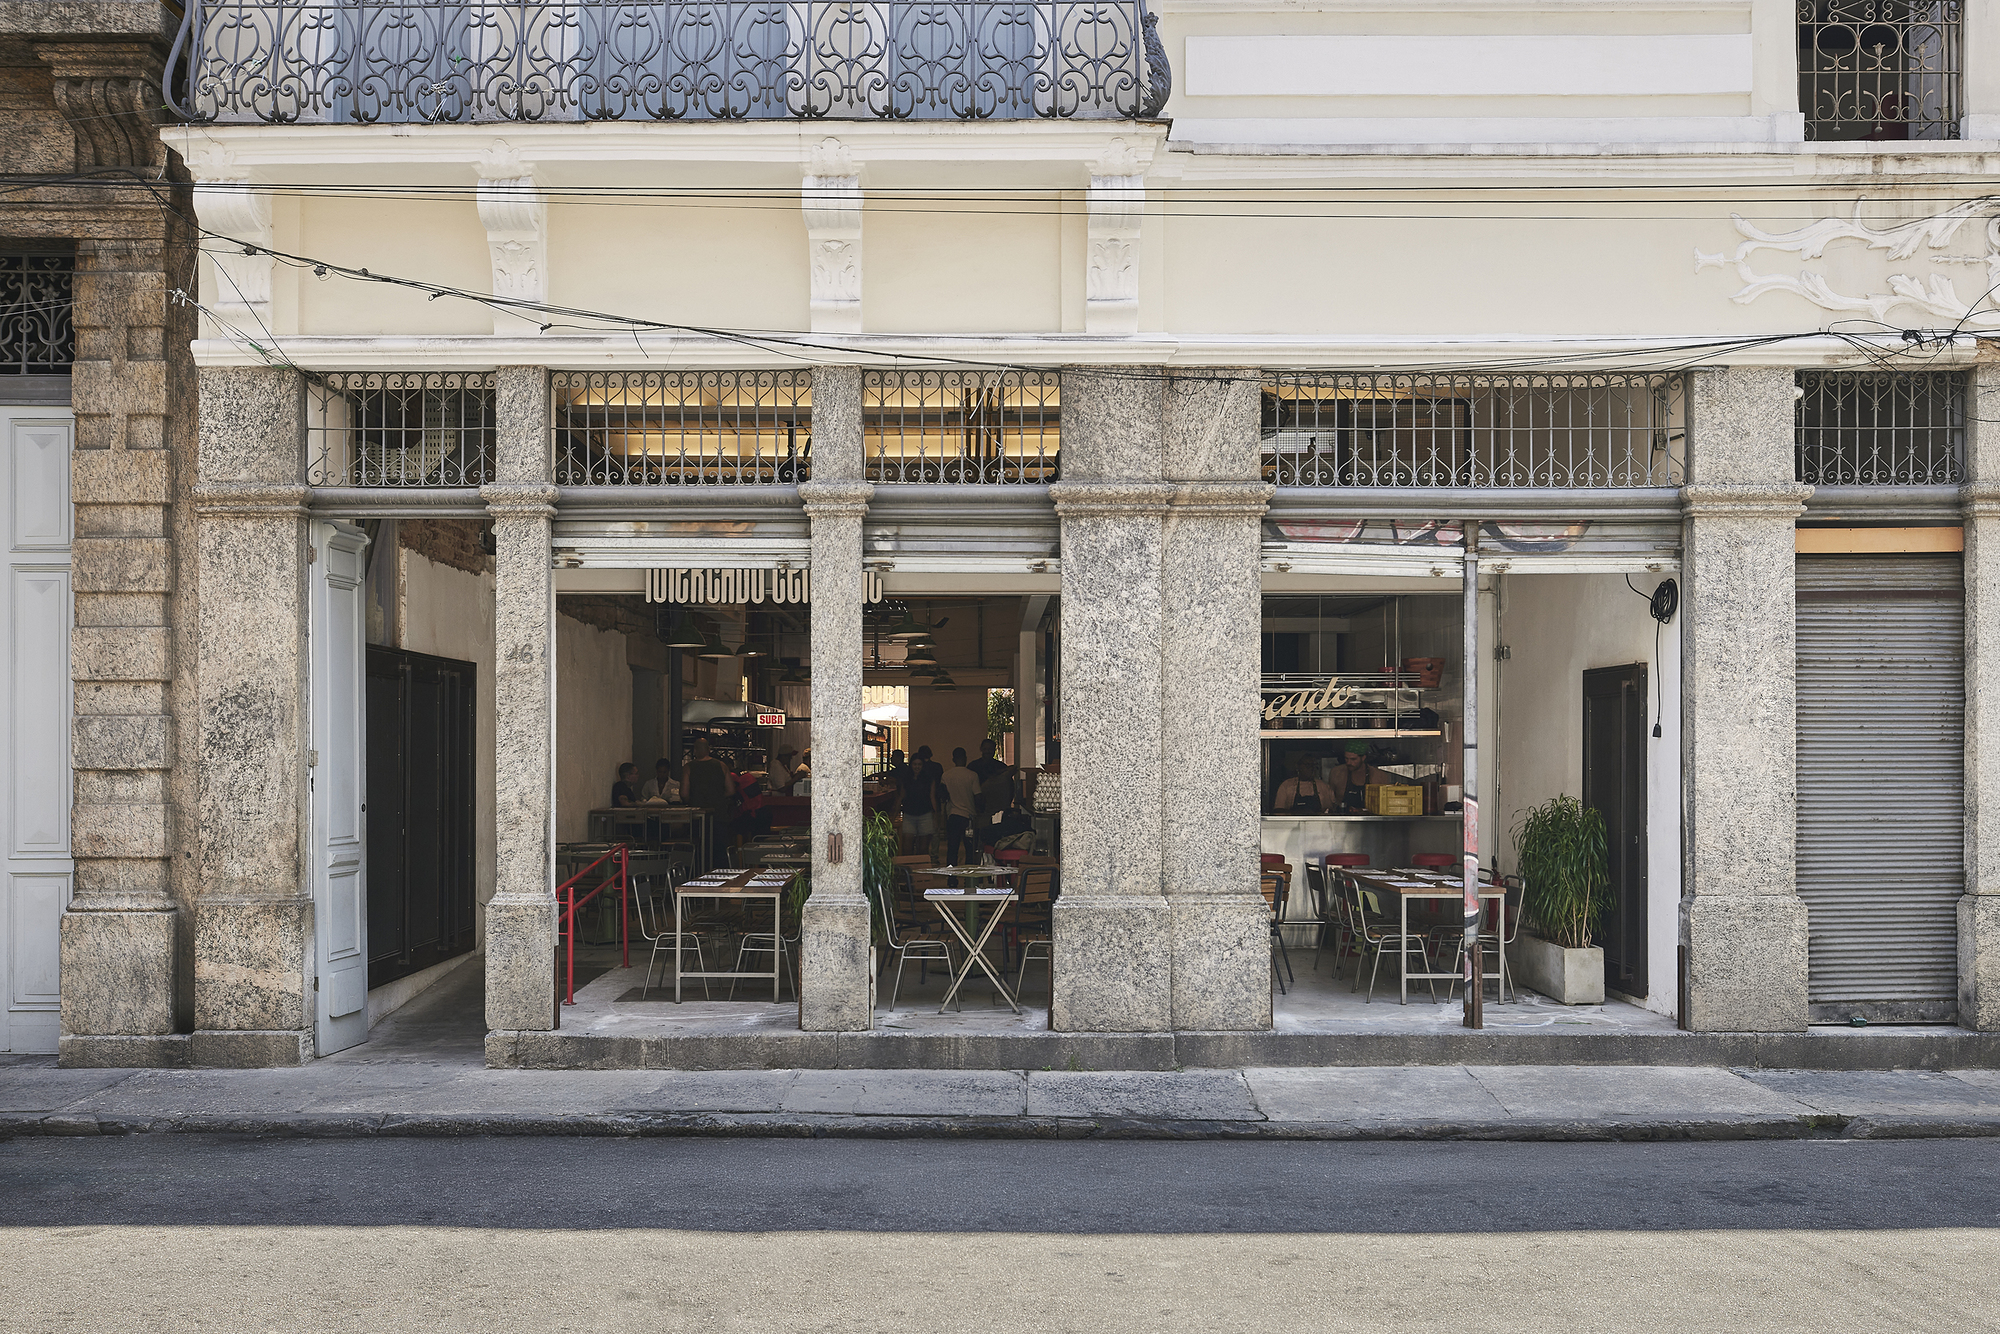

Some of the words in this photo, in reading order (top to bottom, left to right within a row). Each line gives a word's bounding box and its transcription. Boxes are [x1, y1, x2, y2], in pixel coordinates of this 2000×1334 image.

[862, 685, 906, 705] SUBA
[1260, 676, 1352, 721] cado
[759, 714, 783, 725] SUBA
